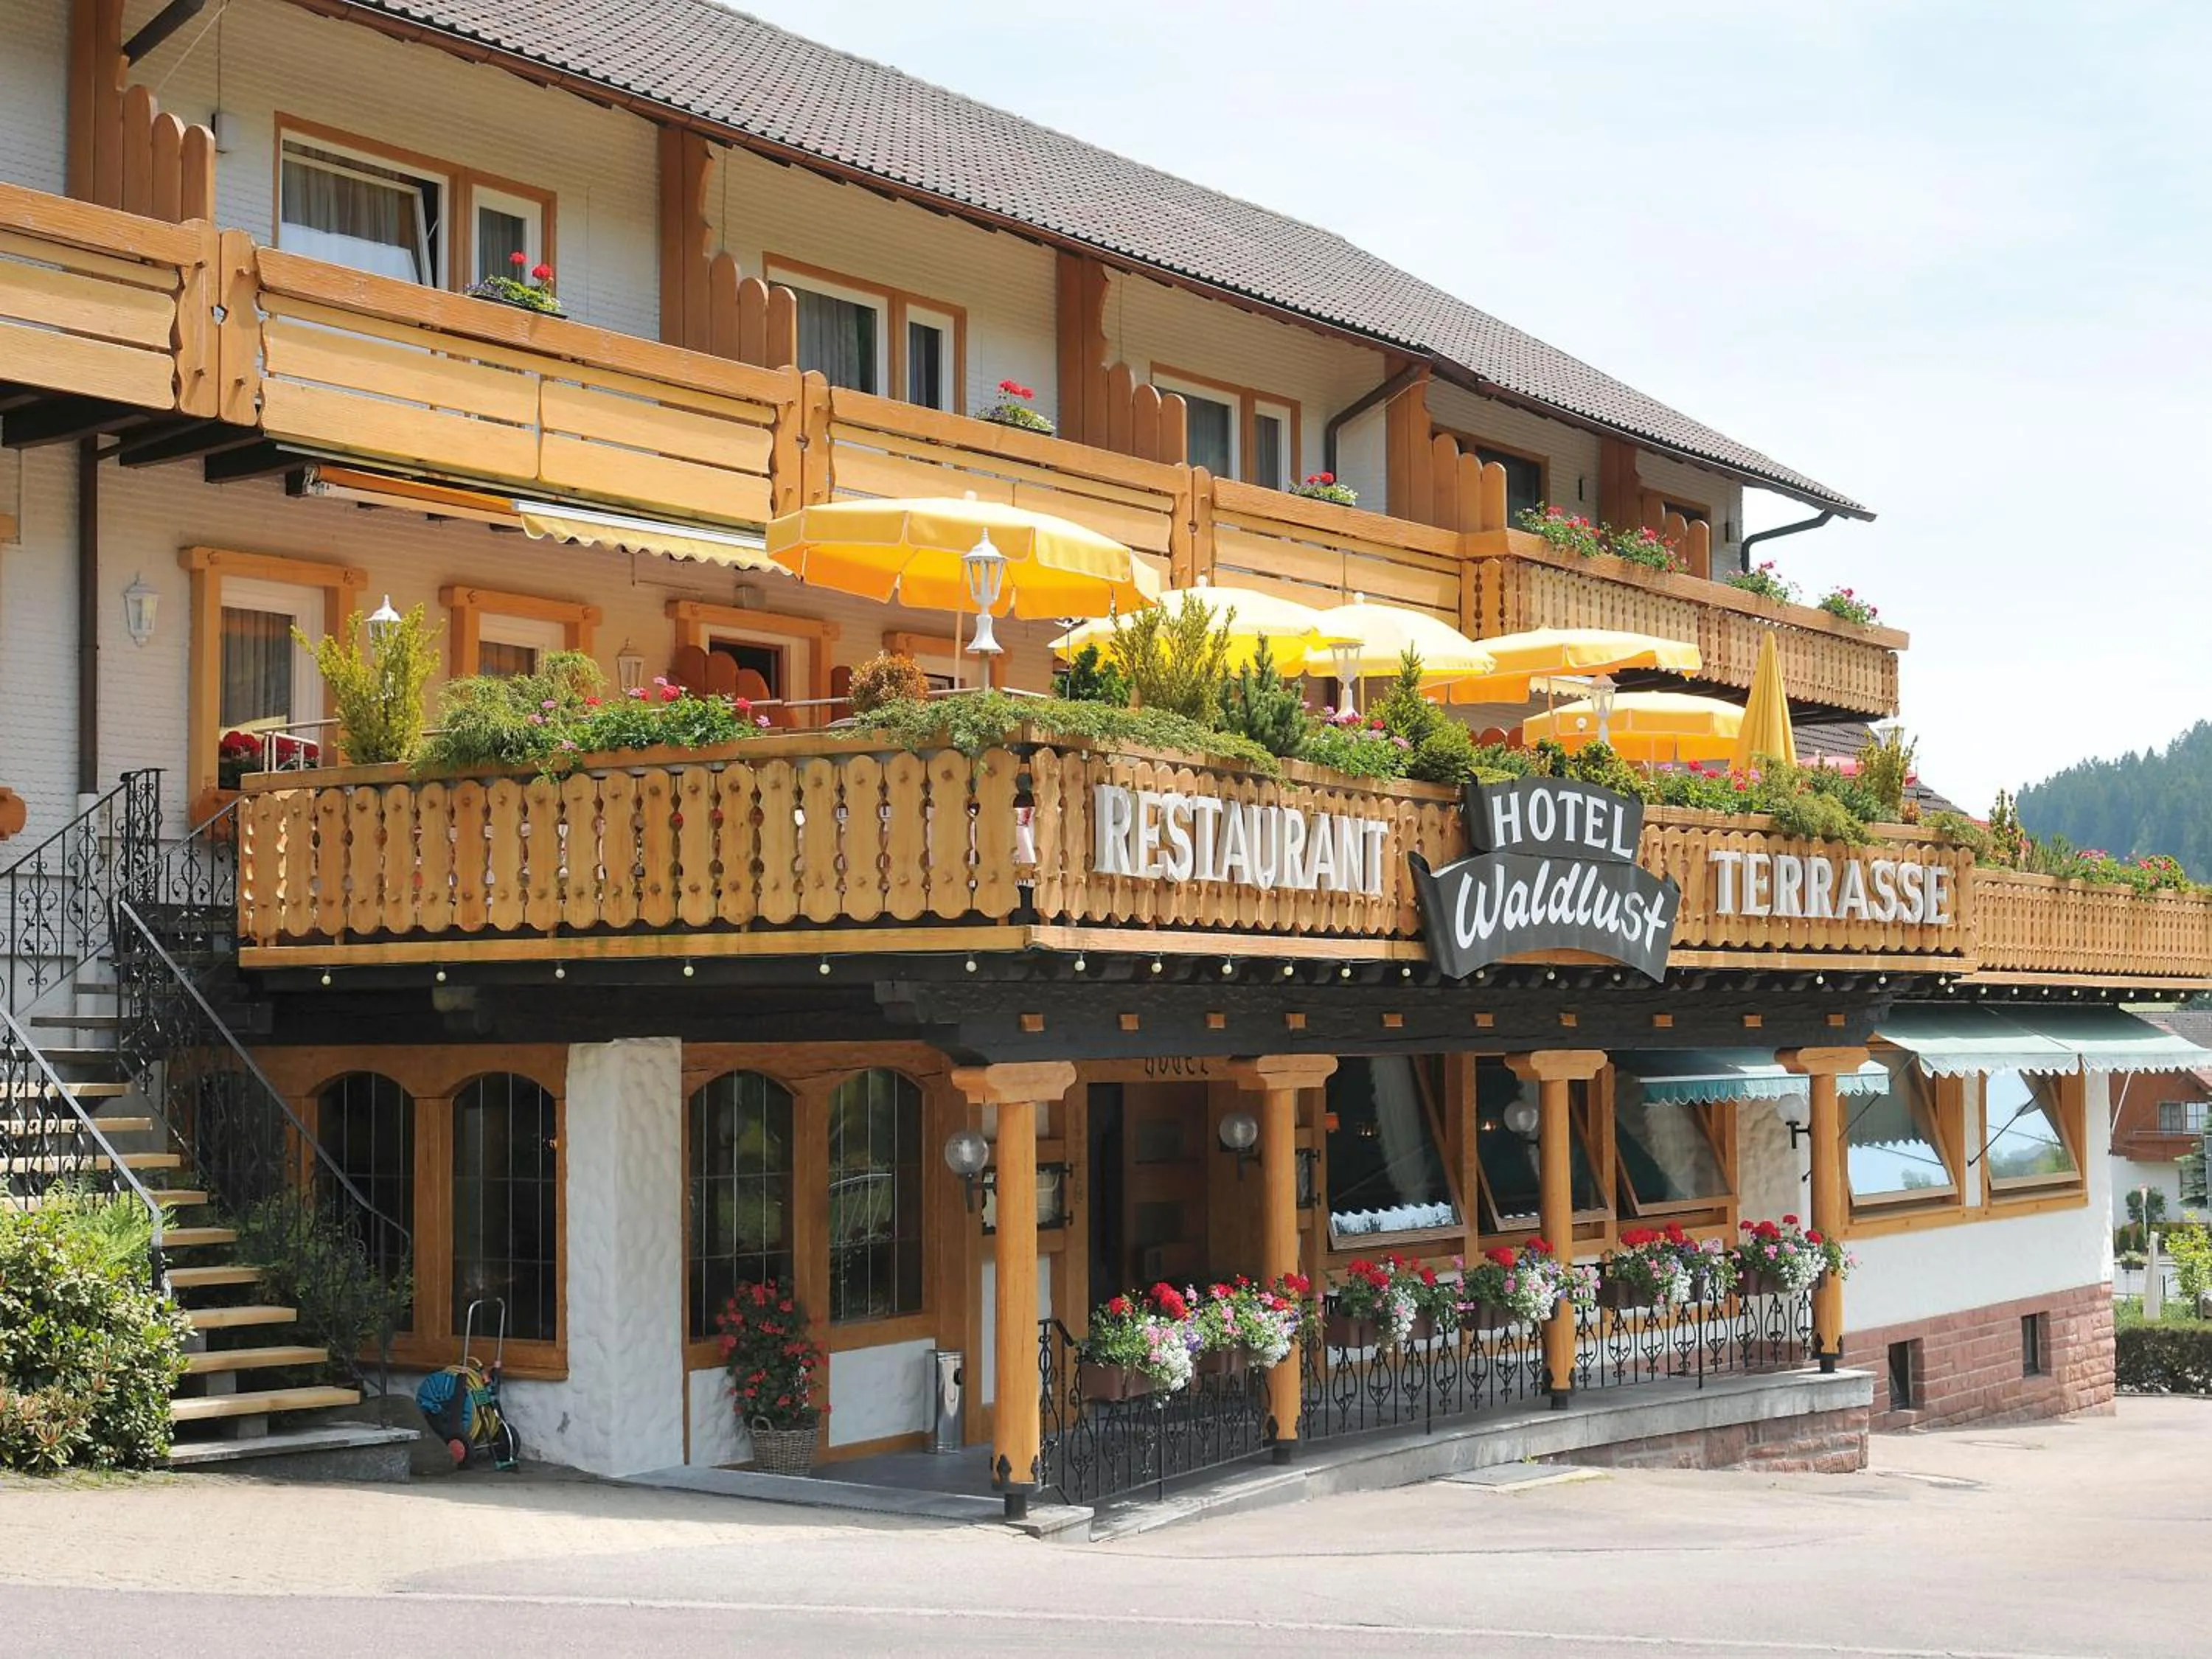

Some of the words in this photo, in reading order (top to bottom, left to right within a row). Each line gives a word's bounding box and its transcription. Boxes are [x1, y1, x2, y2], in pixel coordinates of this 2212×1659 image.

[1093, 784, 1388, 897] RESTAURANT
[1492, 787, 1633, 859] HOTEL
[1455, 860, 1668, 953] Waldlust
[1708, 849, 1950, 924] TERRASSE
